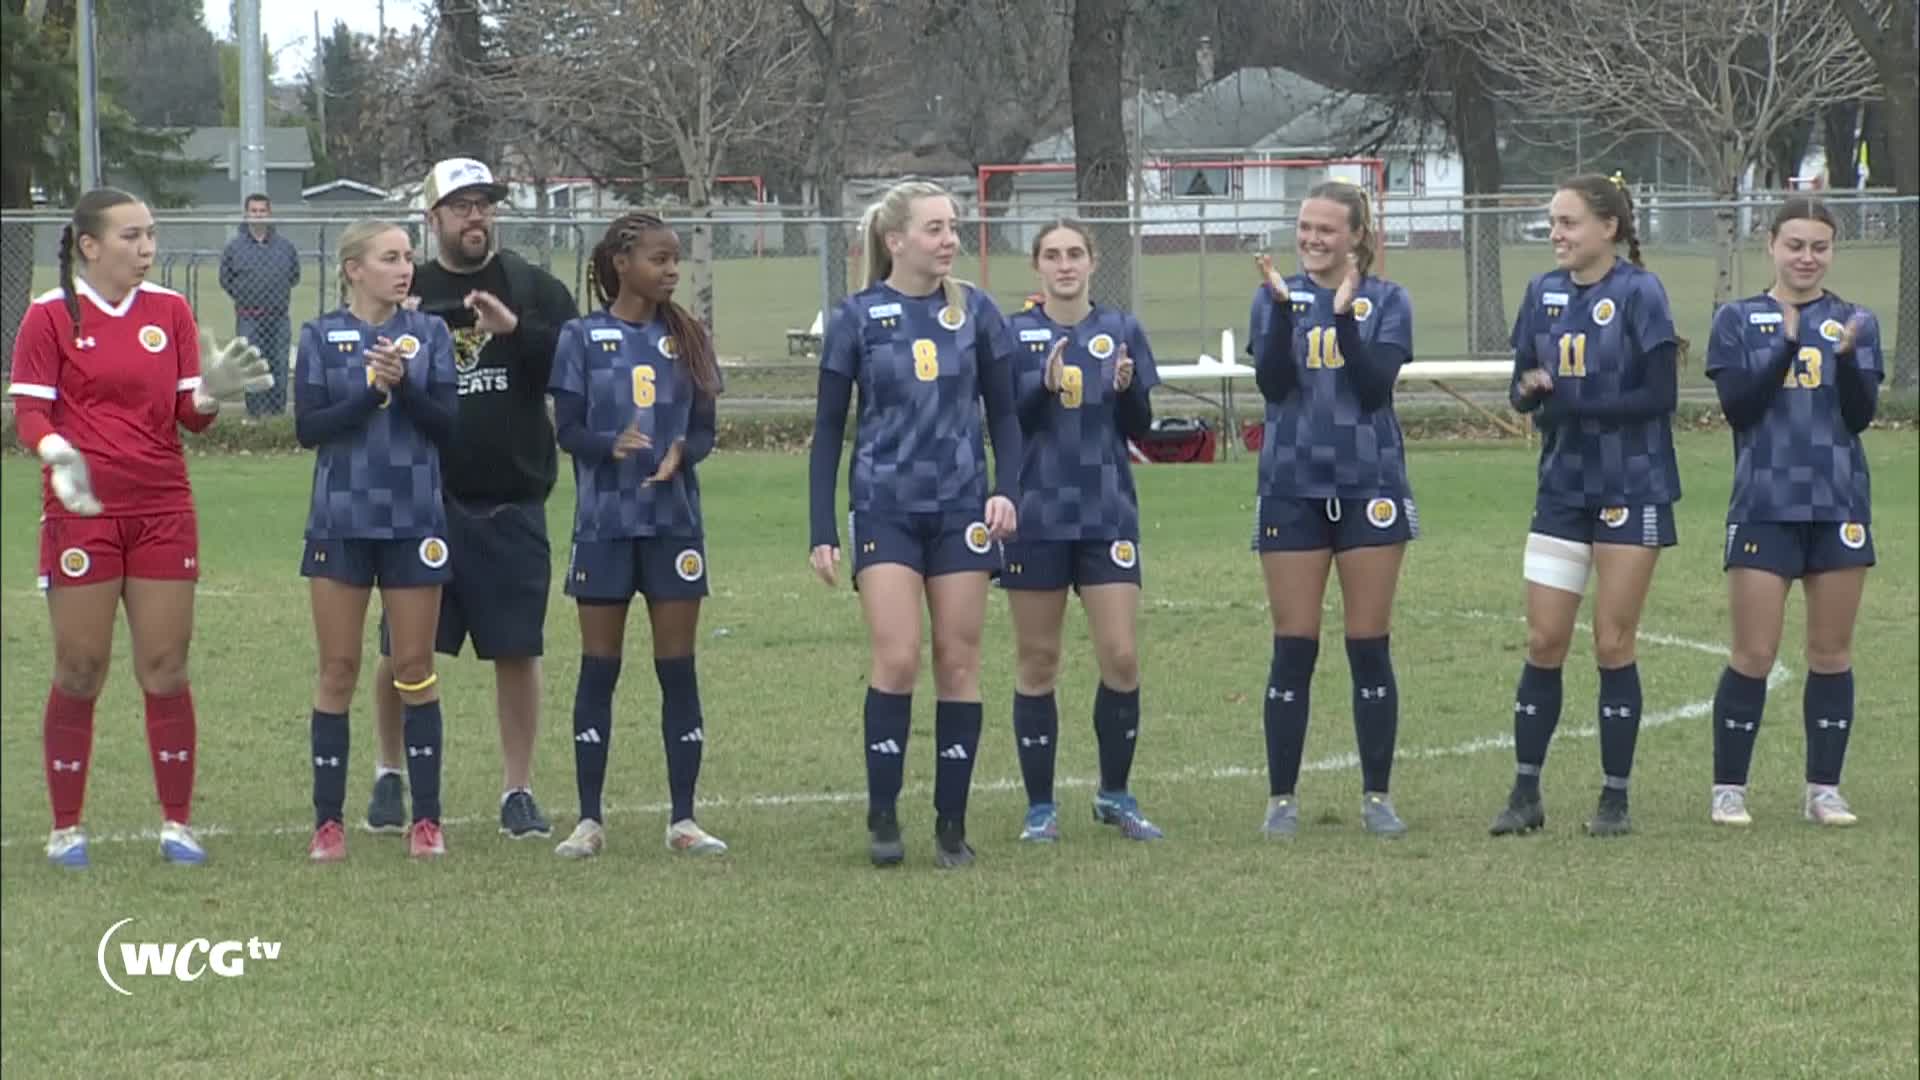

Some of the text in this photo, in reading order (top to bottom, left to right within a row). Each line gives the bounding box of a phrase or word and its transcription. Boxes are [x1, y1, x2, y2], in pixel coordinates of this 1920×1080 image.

[912, 339, 938, 381] 8
[1558, 333, 1586, 377] 11
[632, 365, 656, 408] 6
[1060, 365, 1083, 408] 9
